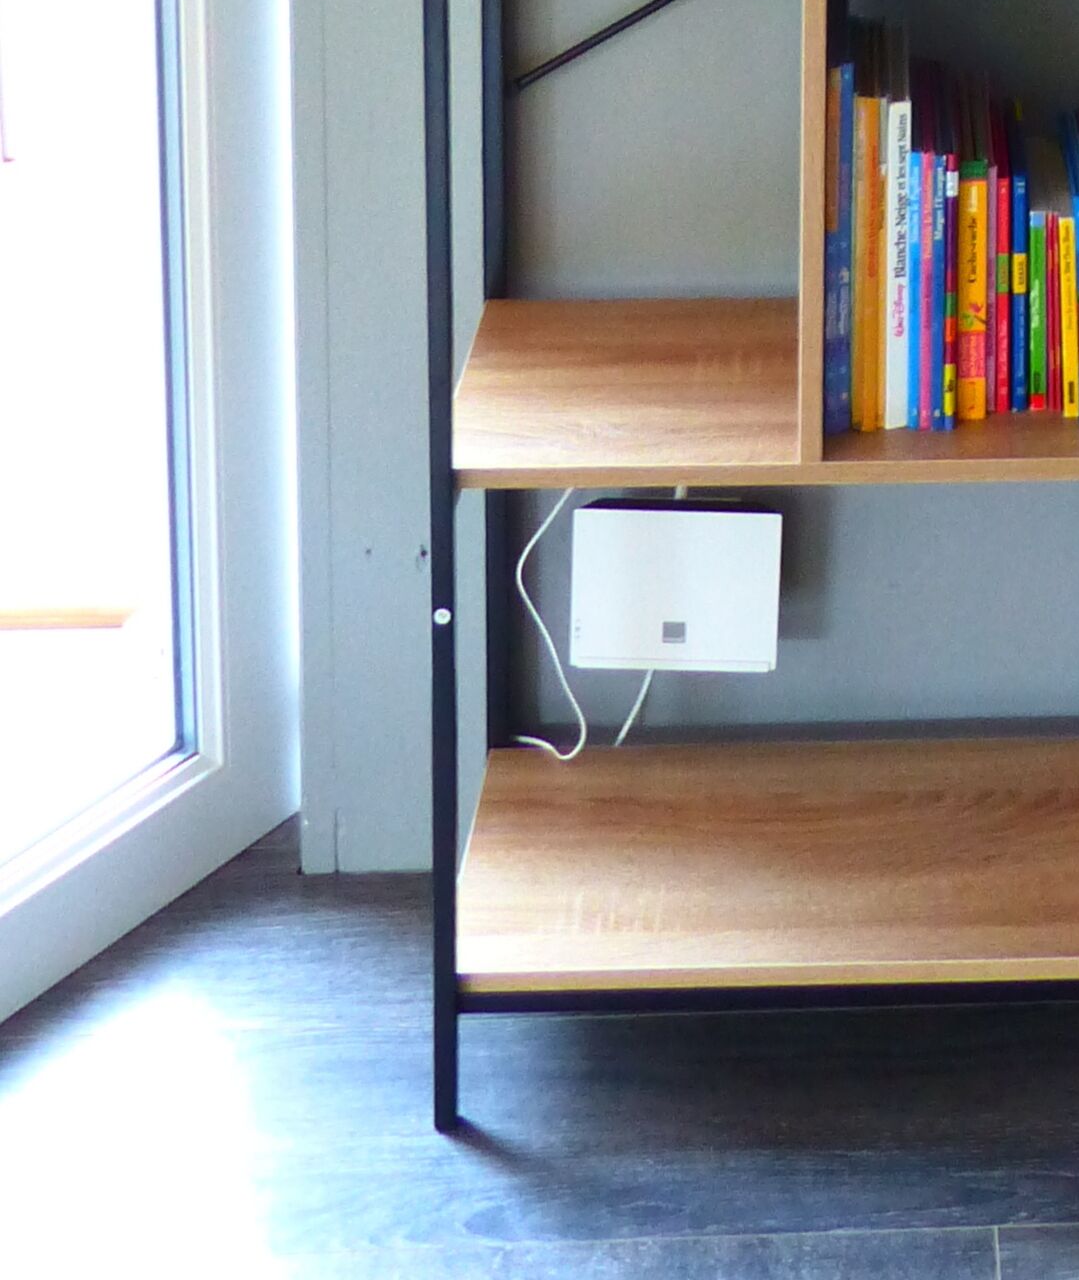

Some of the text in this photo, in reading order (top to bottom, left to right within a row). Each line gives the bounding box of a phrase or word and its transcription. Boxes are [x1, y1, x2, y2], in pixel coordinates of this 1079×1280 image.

[896, 114, 908, 142] Nains
[898, 144, 909, 164] sept
[896, 166, 907, 179] les
[898, 181, 907, 190] et
